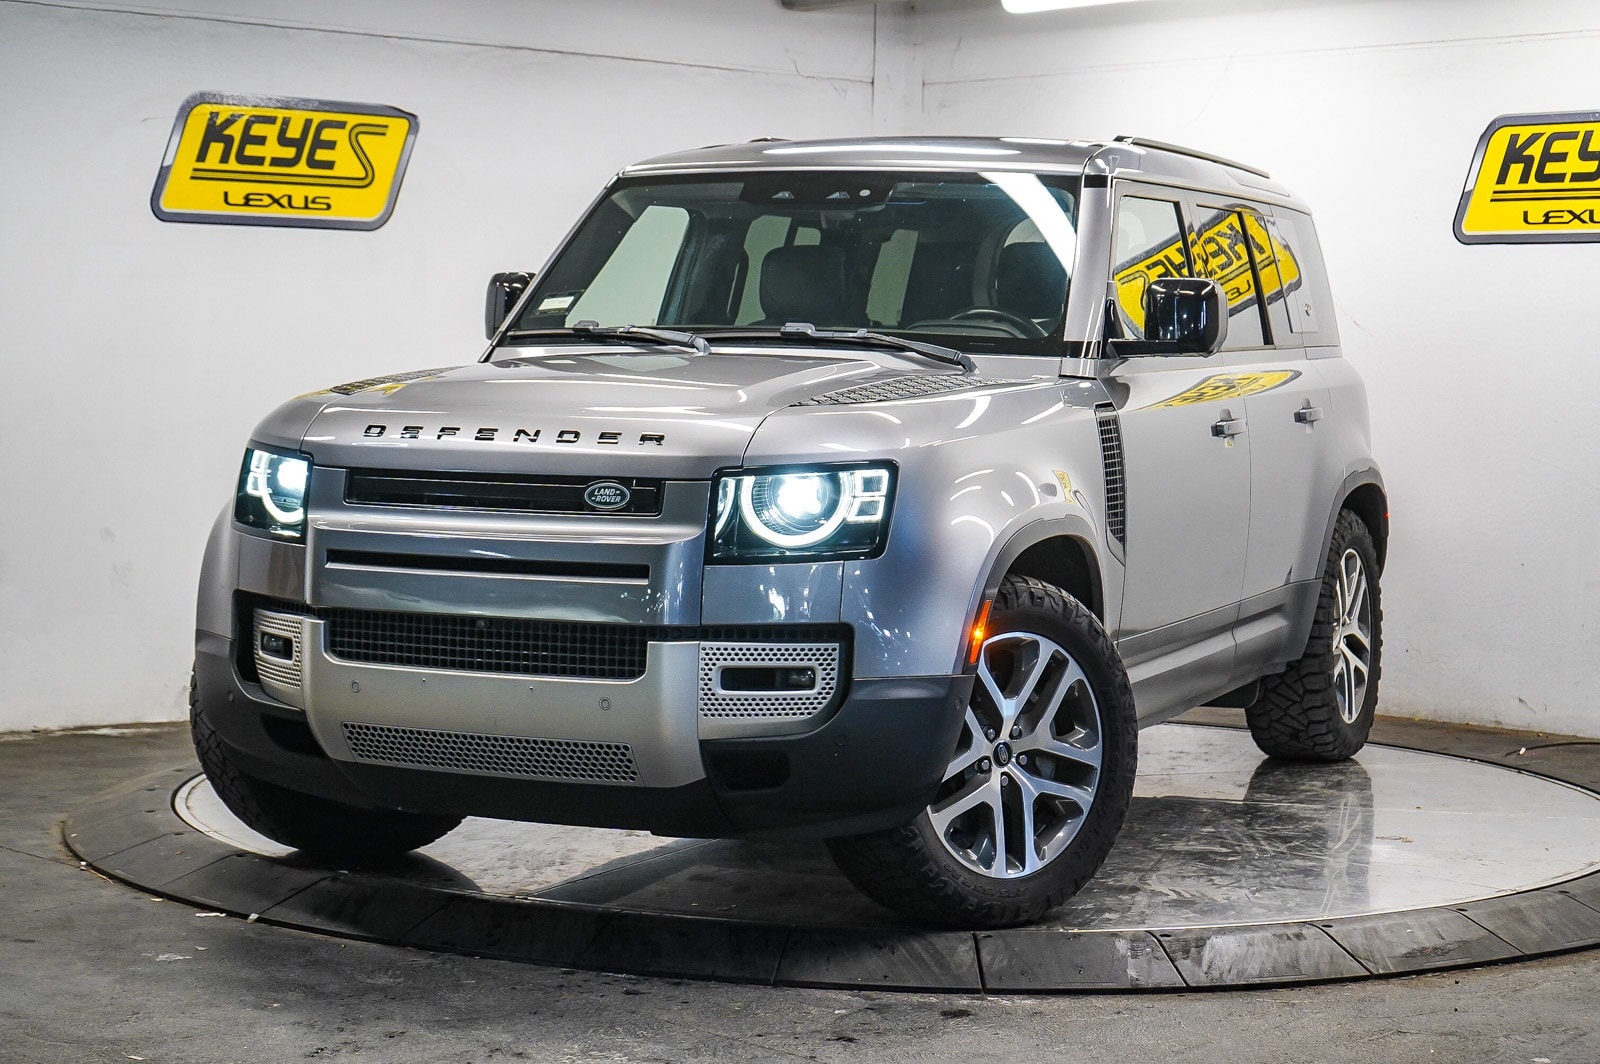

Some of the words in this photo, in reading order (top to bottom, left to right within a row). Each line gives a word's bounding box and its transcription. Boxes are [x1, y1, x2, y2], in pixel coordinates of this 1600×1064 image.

[190, 112, 389, 189] KEYES
[223, 191, 332, 211] LEXUS
[362, 424, 666, 446] DEFENDER
